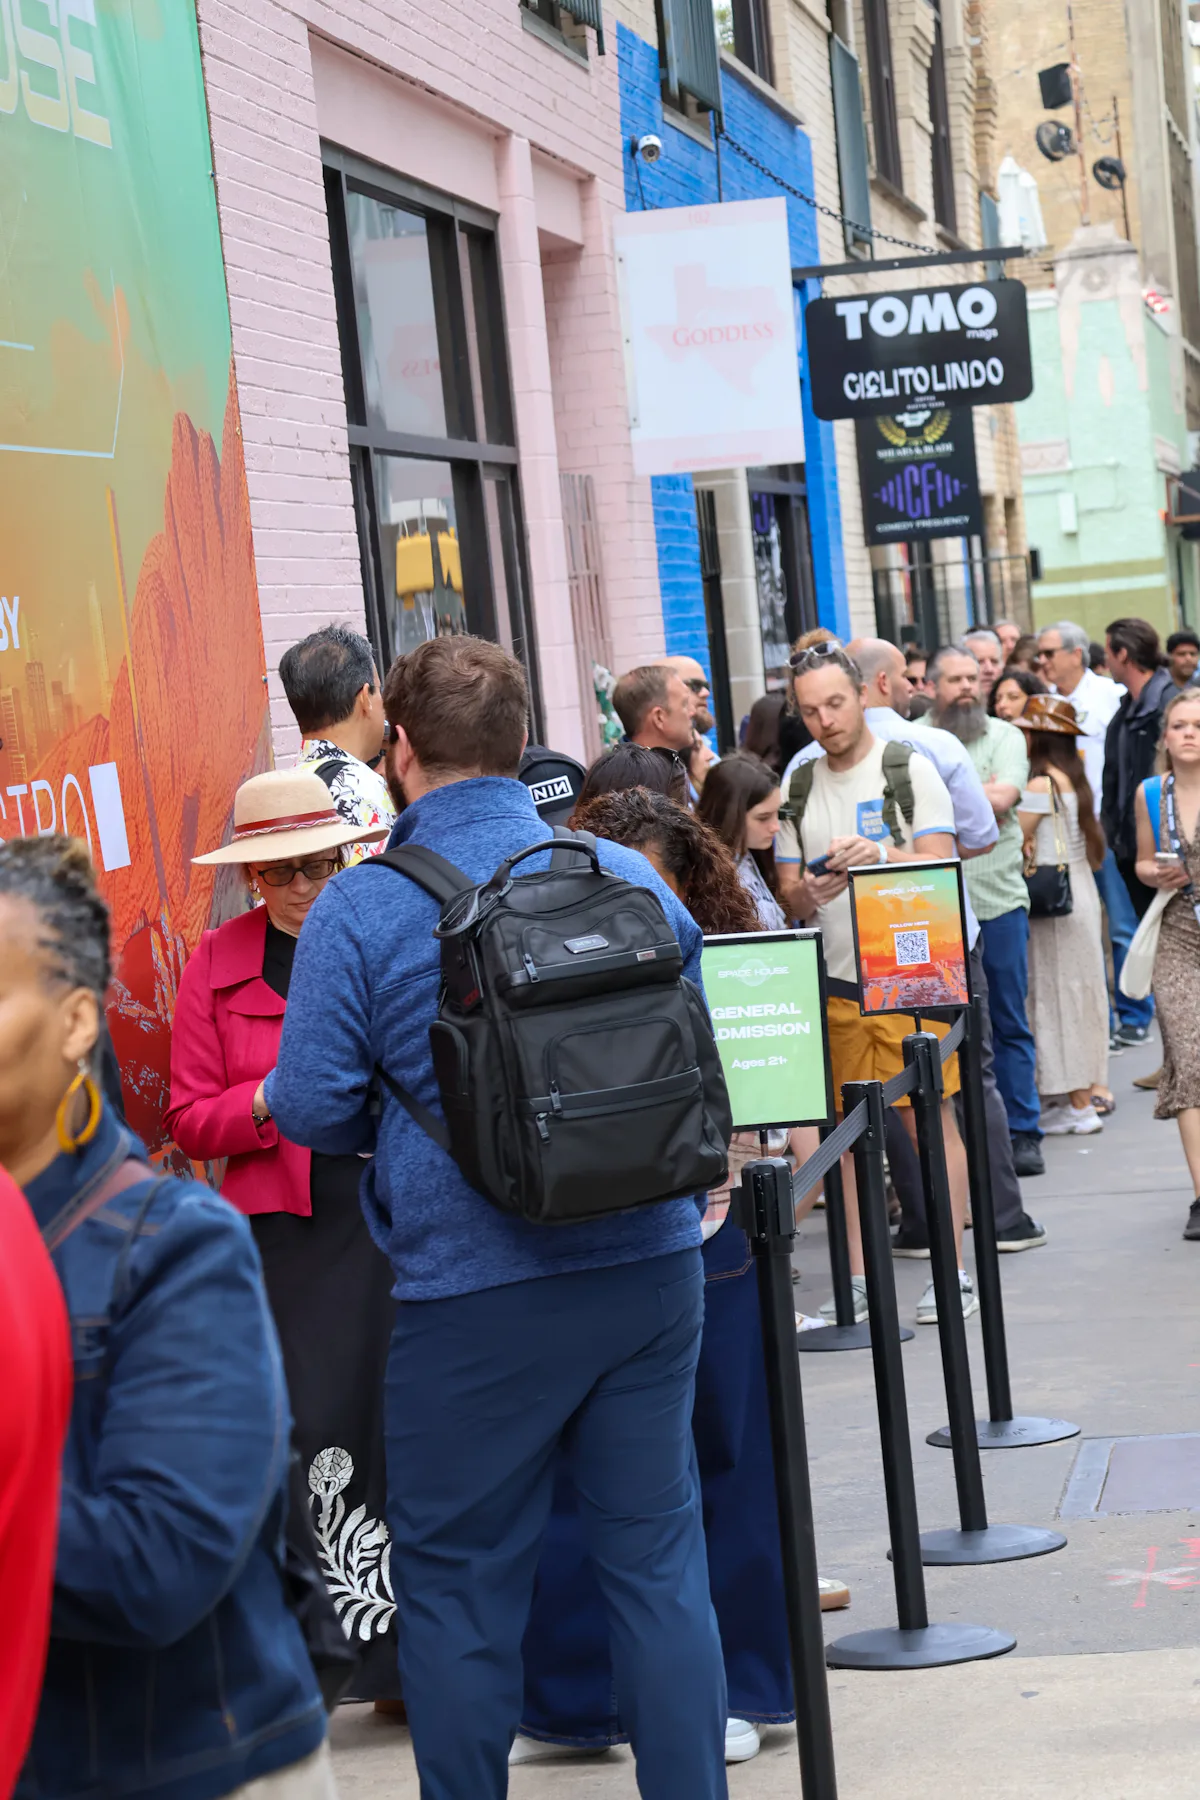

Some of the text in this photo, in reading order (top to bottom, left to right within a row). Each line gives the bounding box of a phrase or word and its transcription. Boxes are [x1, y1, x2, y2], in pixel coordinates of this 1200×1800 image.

[835, 287, 998, 341] TOMO
[672, 321, 774, 347] GODDESS
[966, 327, 999, 341] mags
[876, 515, 970, 533] COMEDY FREQUENCY
[889, 921, 913, 929] FOLLOW
[717, 966, 790, 979] SPACE HOUSE
[711, 1002, 802, 1020] GENERAL
[713, 1021, 811, 1042] DMISSION
[731, 1055, 789, 1070] Ages 21+
